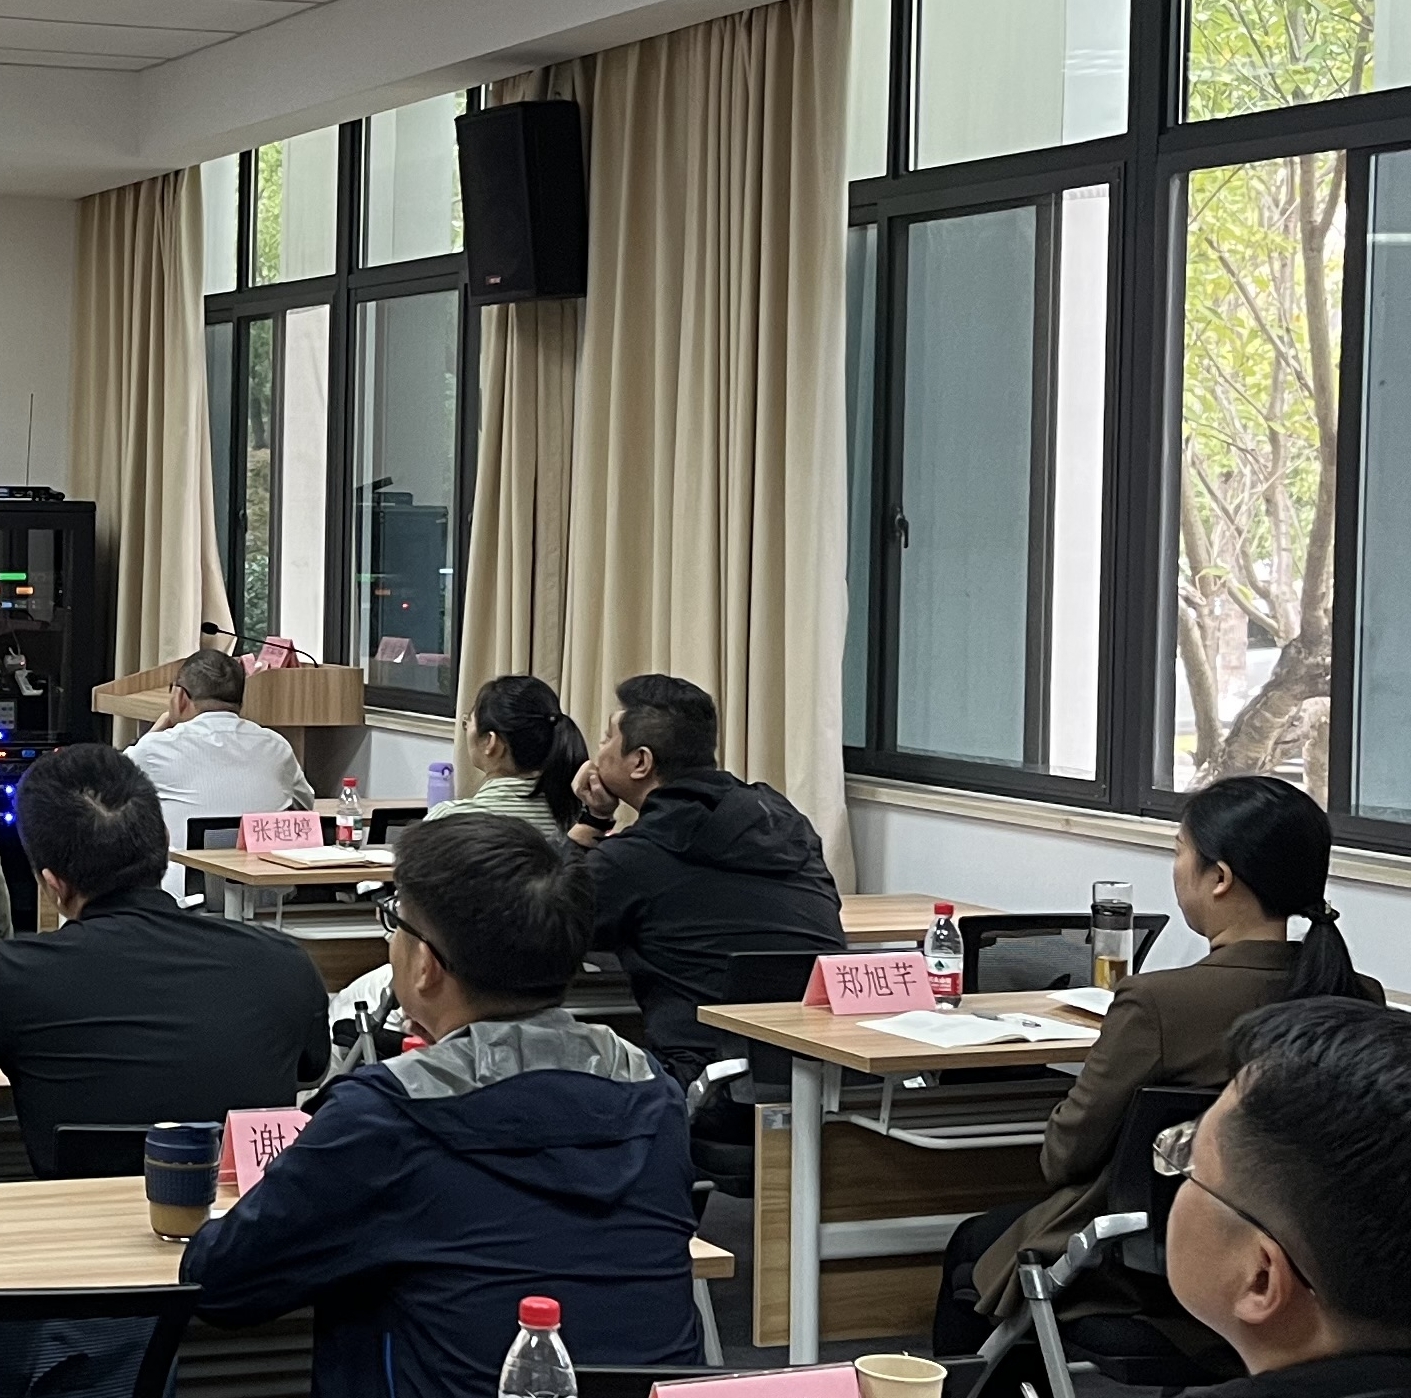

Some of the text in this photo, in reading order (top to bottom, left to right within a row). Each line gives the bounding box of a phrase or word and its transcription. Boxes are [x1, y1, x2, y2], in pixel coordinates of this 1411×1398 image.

[252, 817, 312, 842] 张超婷
[835, 961, 917, 999] 郑旭芊
[249, 1122, 302, 1172] 谢
